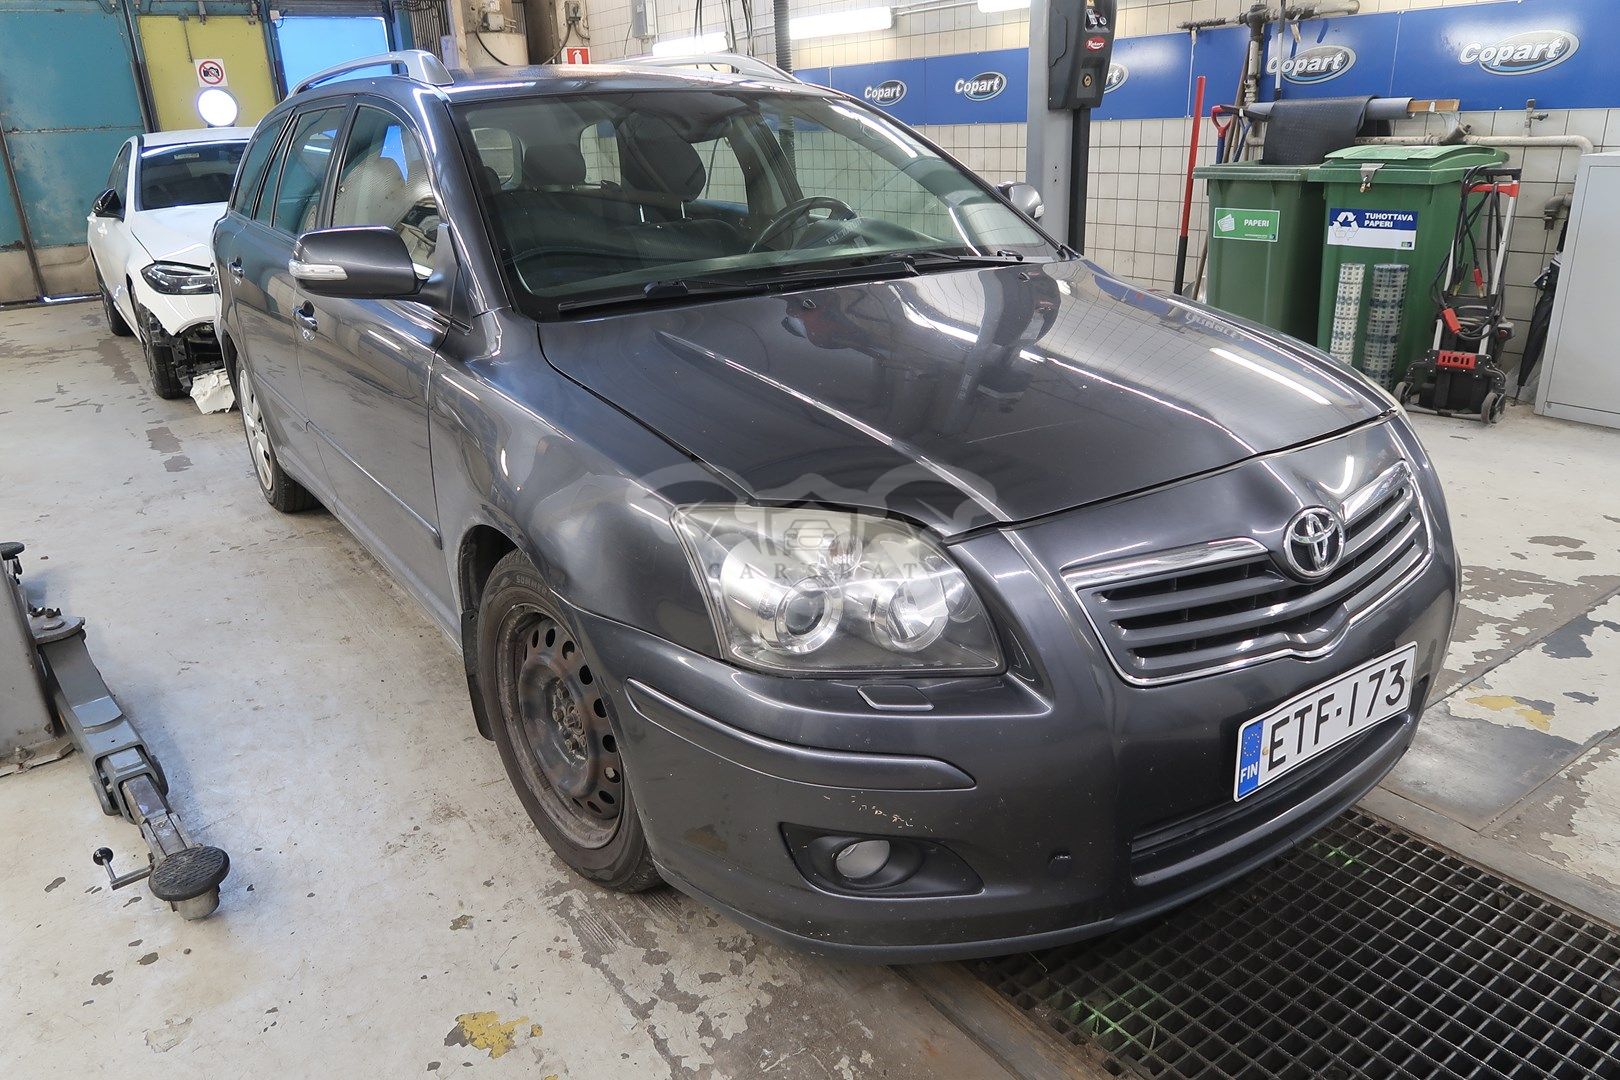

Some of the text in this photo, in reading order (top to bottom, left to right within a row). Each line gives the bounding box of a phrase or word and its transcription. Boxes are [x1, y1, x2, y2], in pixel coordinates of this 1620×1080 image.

[1459, 37, 1563, 67] Copart
[1265, 52, 1344, 77] Copart
[864, 84, 901, 101] Copart
[955, 77, 1001, 95] Copart
[1243, 218, 1270, 228] PAPERI
[1363, 220, 1394, 228] PAPERI
[1364, 212, 1414, 222] TUHOTTAVA
[1267, 658, 1408, 772] ETF-173
[1239, 761, 1259, 784] FIN
